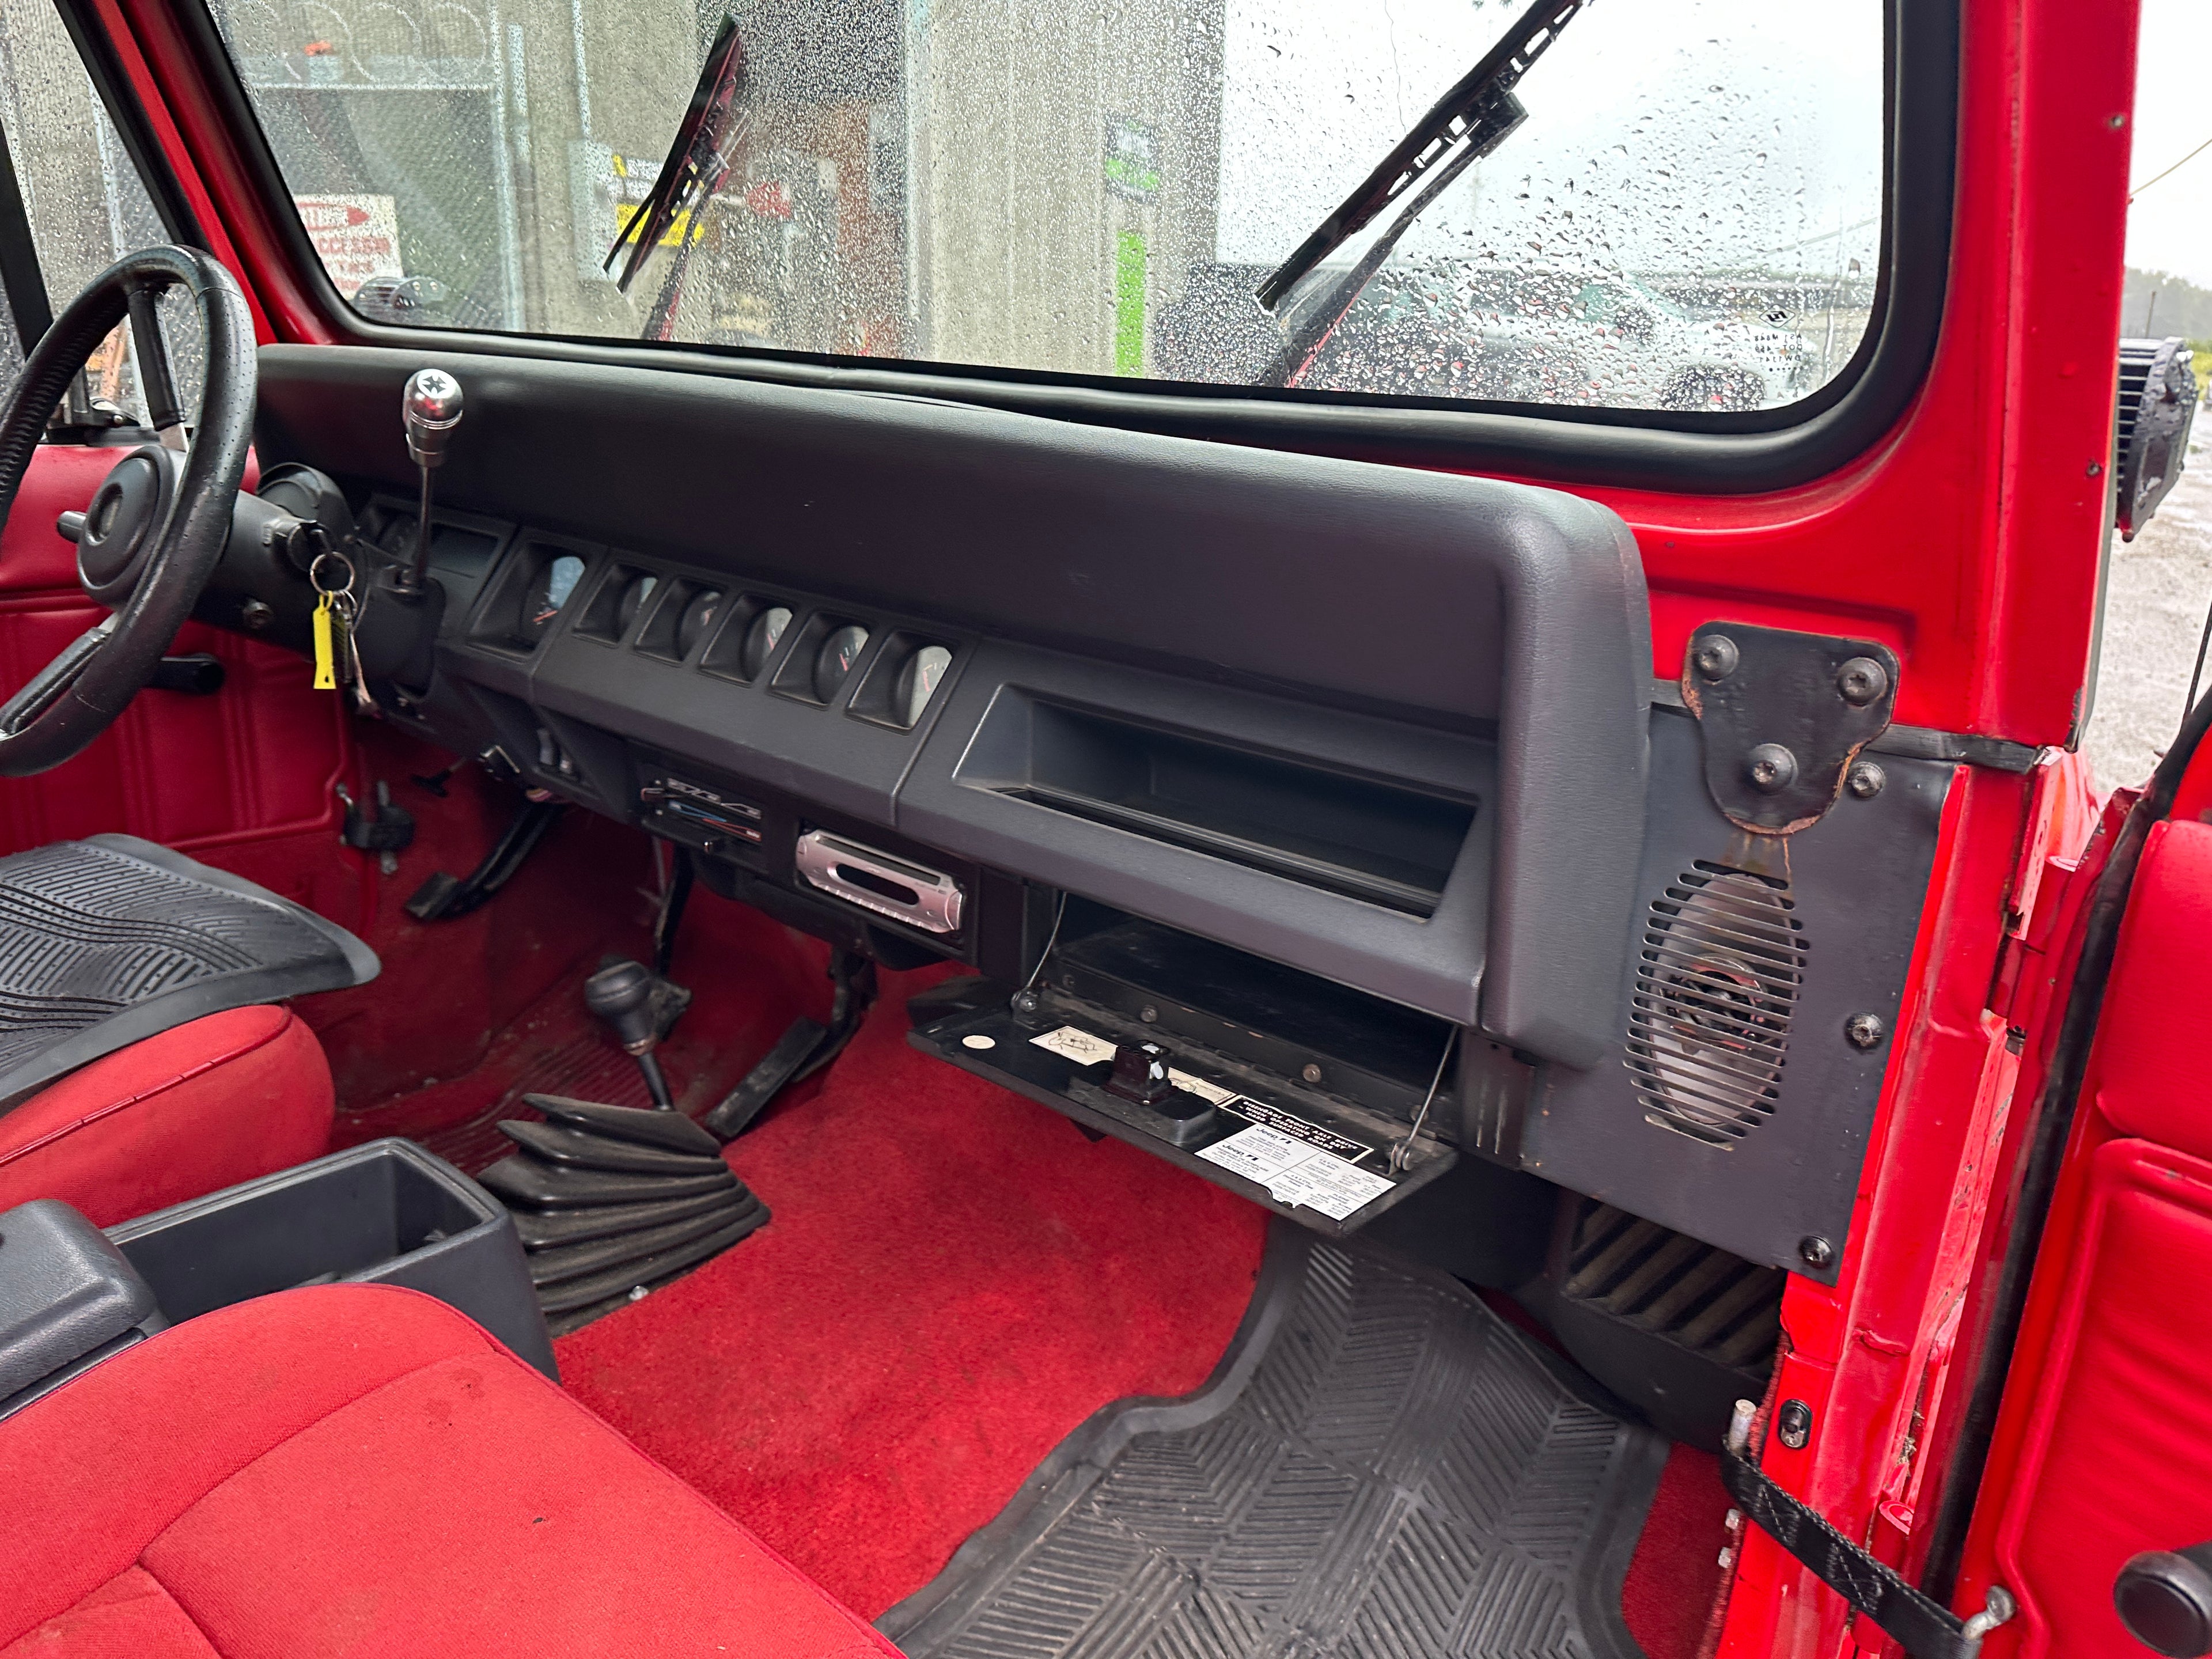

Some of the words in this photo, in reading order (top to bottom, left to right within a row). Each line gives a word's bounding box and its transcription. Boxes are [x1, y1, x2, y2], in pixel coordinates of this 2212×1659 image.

[1243, 1101, 1282, 1119] DISENGAGE
[1285, 1118, 1309, 1131] FRONT
[1312, 1130, 1332, 1139] AXLE
[1335, 1138, 1358, 1150] DRIVE
[1245, 1107, 1268, 1118] WHEN
[1270, 1116, 1310, 1136] OPERATING
[1330, 1141, 1345, 1150] DRY
[1246, 1111, 1266, 1122] HARD
[1268, 1121, 1304, 1138] SURFACED
[1307, 1137, 1334, 1150] ROADS
[1256, 1128, 1278, 1140] Jeep
[1222, 1145, 1244, 1156] Jeep
